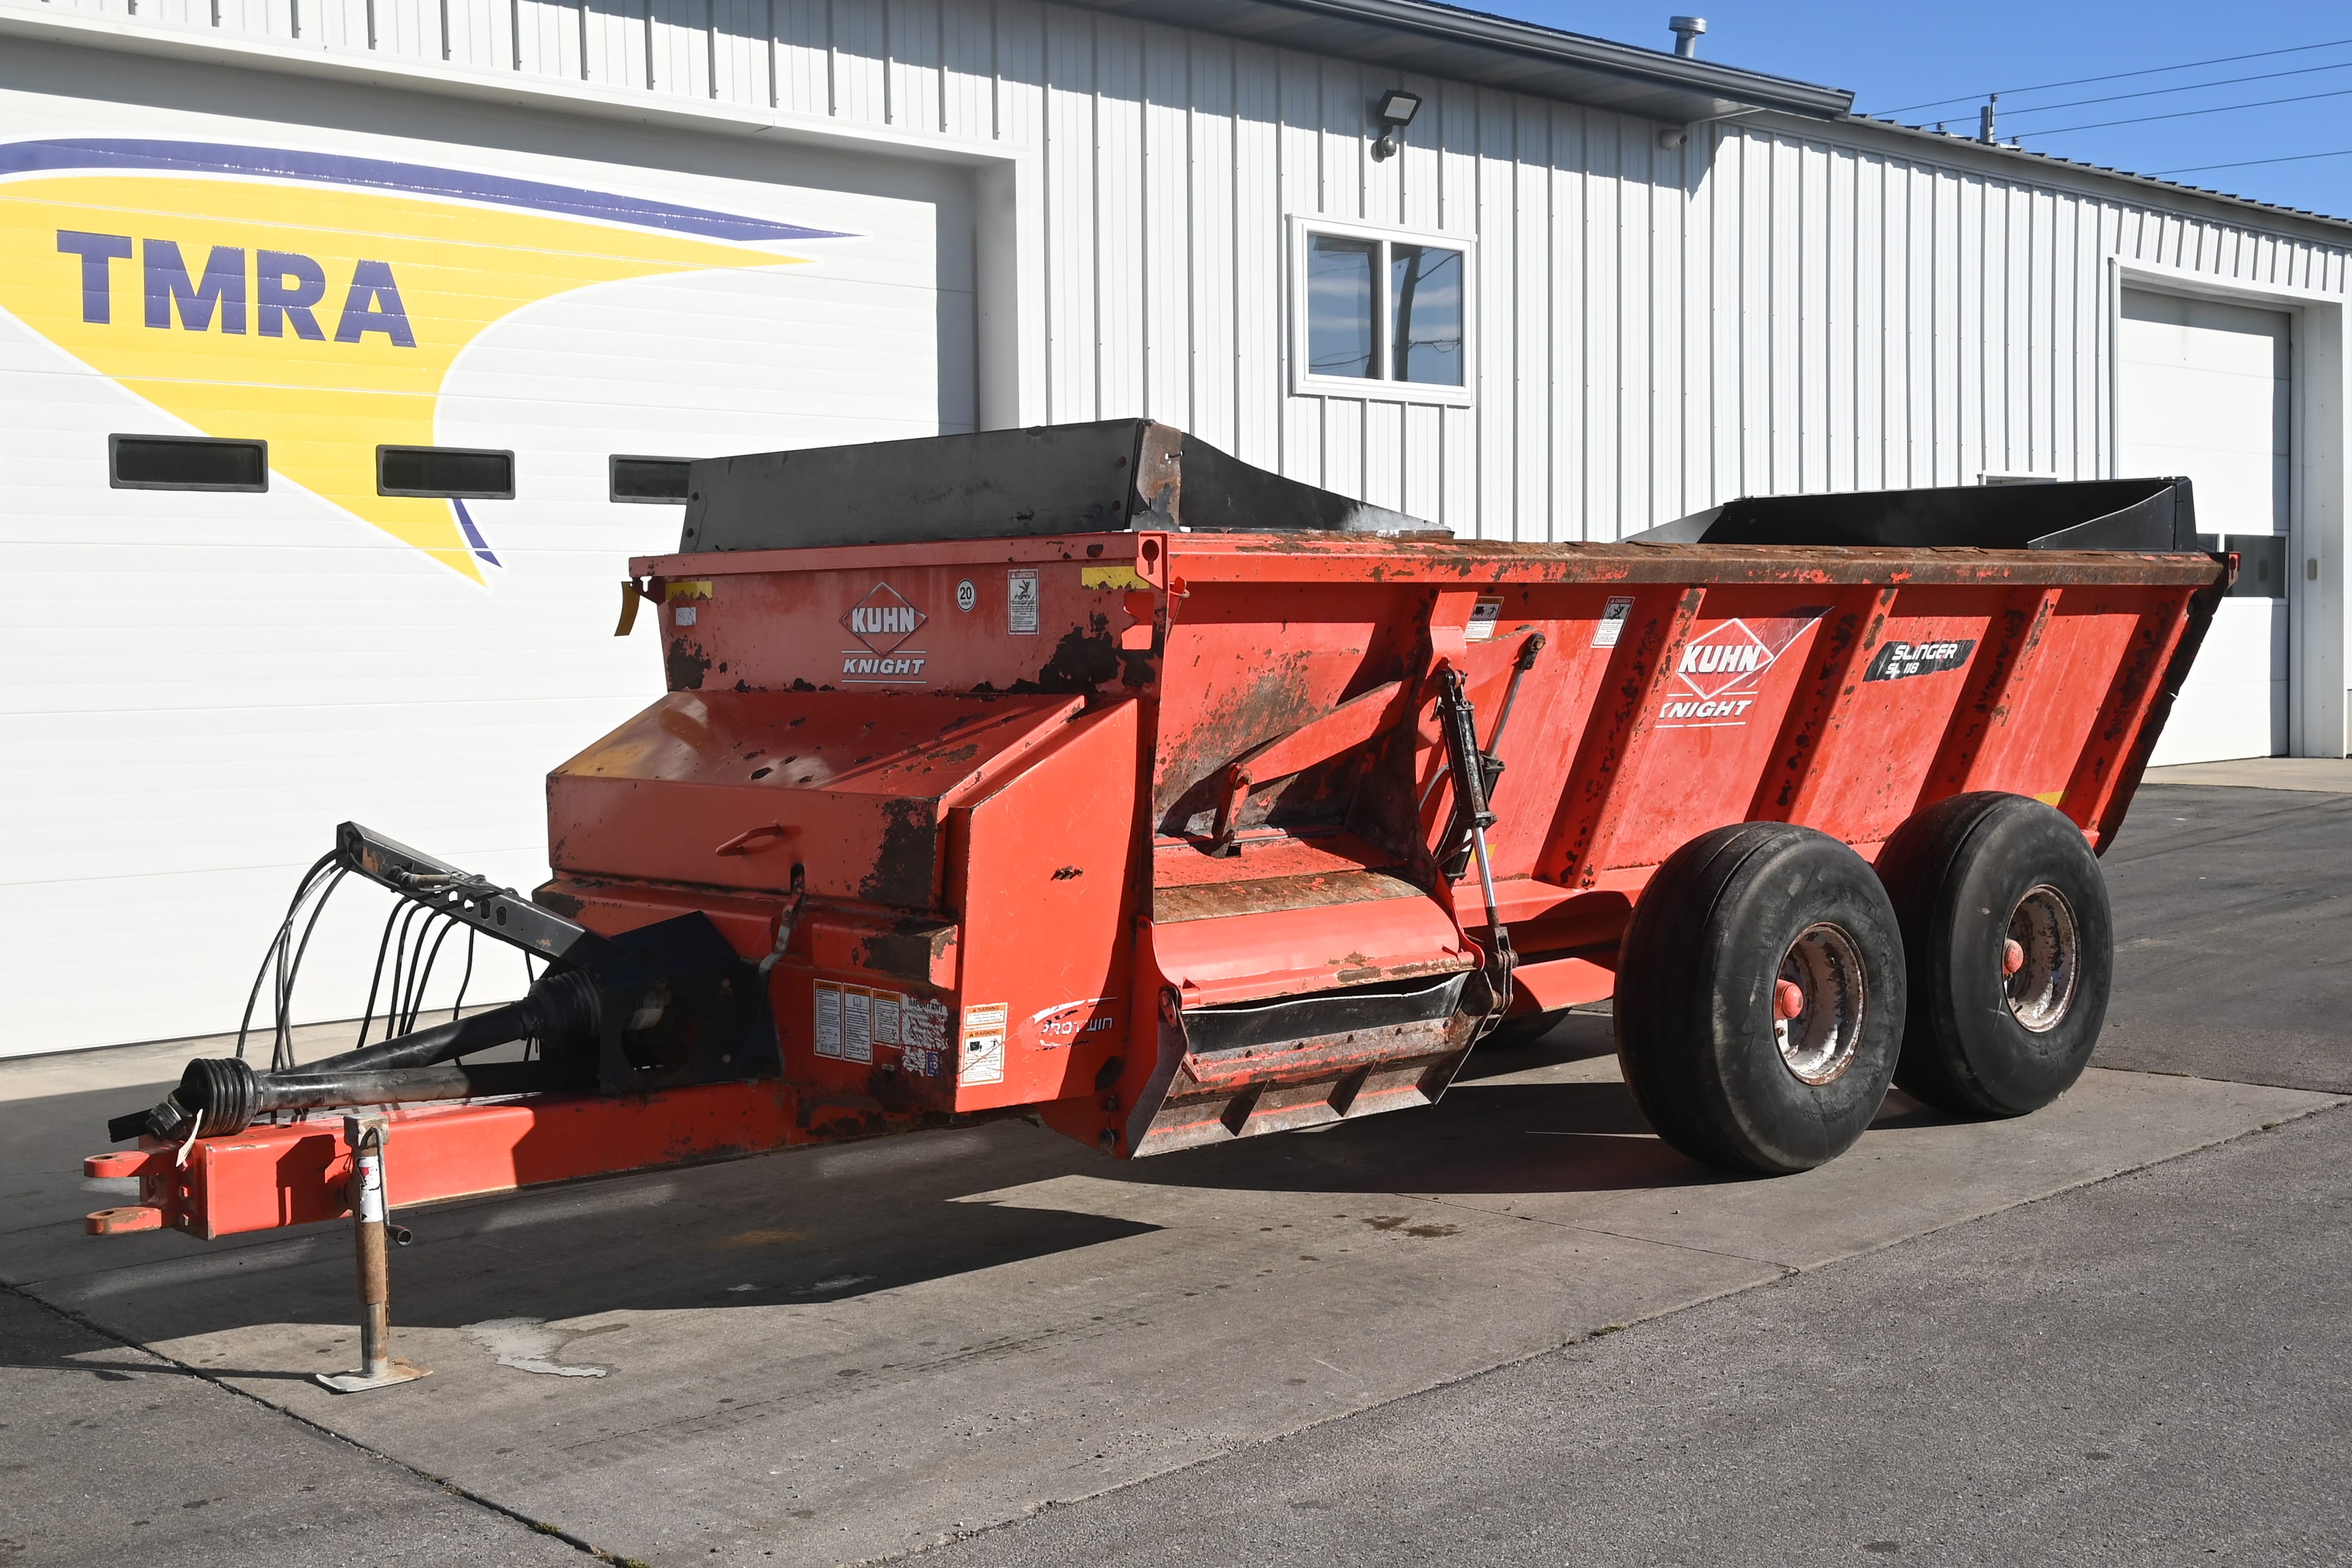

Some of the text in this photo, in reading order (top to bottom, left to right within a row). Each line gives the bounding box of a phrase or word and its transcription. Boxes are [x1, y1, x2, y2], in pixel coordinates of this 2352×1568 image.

[56, 229, 416, 348] TMRA
[960, 587, 972, 599] 20
[852, 607, 915, 632] KUHN
[1677, 645, 1763, 673] KUHN
[1891, 644, 1958, 661] SLINGER
[843, 659, 924, 673] KNIGHT
[1903, 662, 1919, 674] 118
[1659, 700, 1753, 719] KNIGHT
[908, 999, 942, 1013] IMPORTANT
